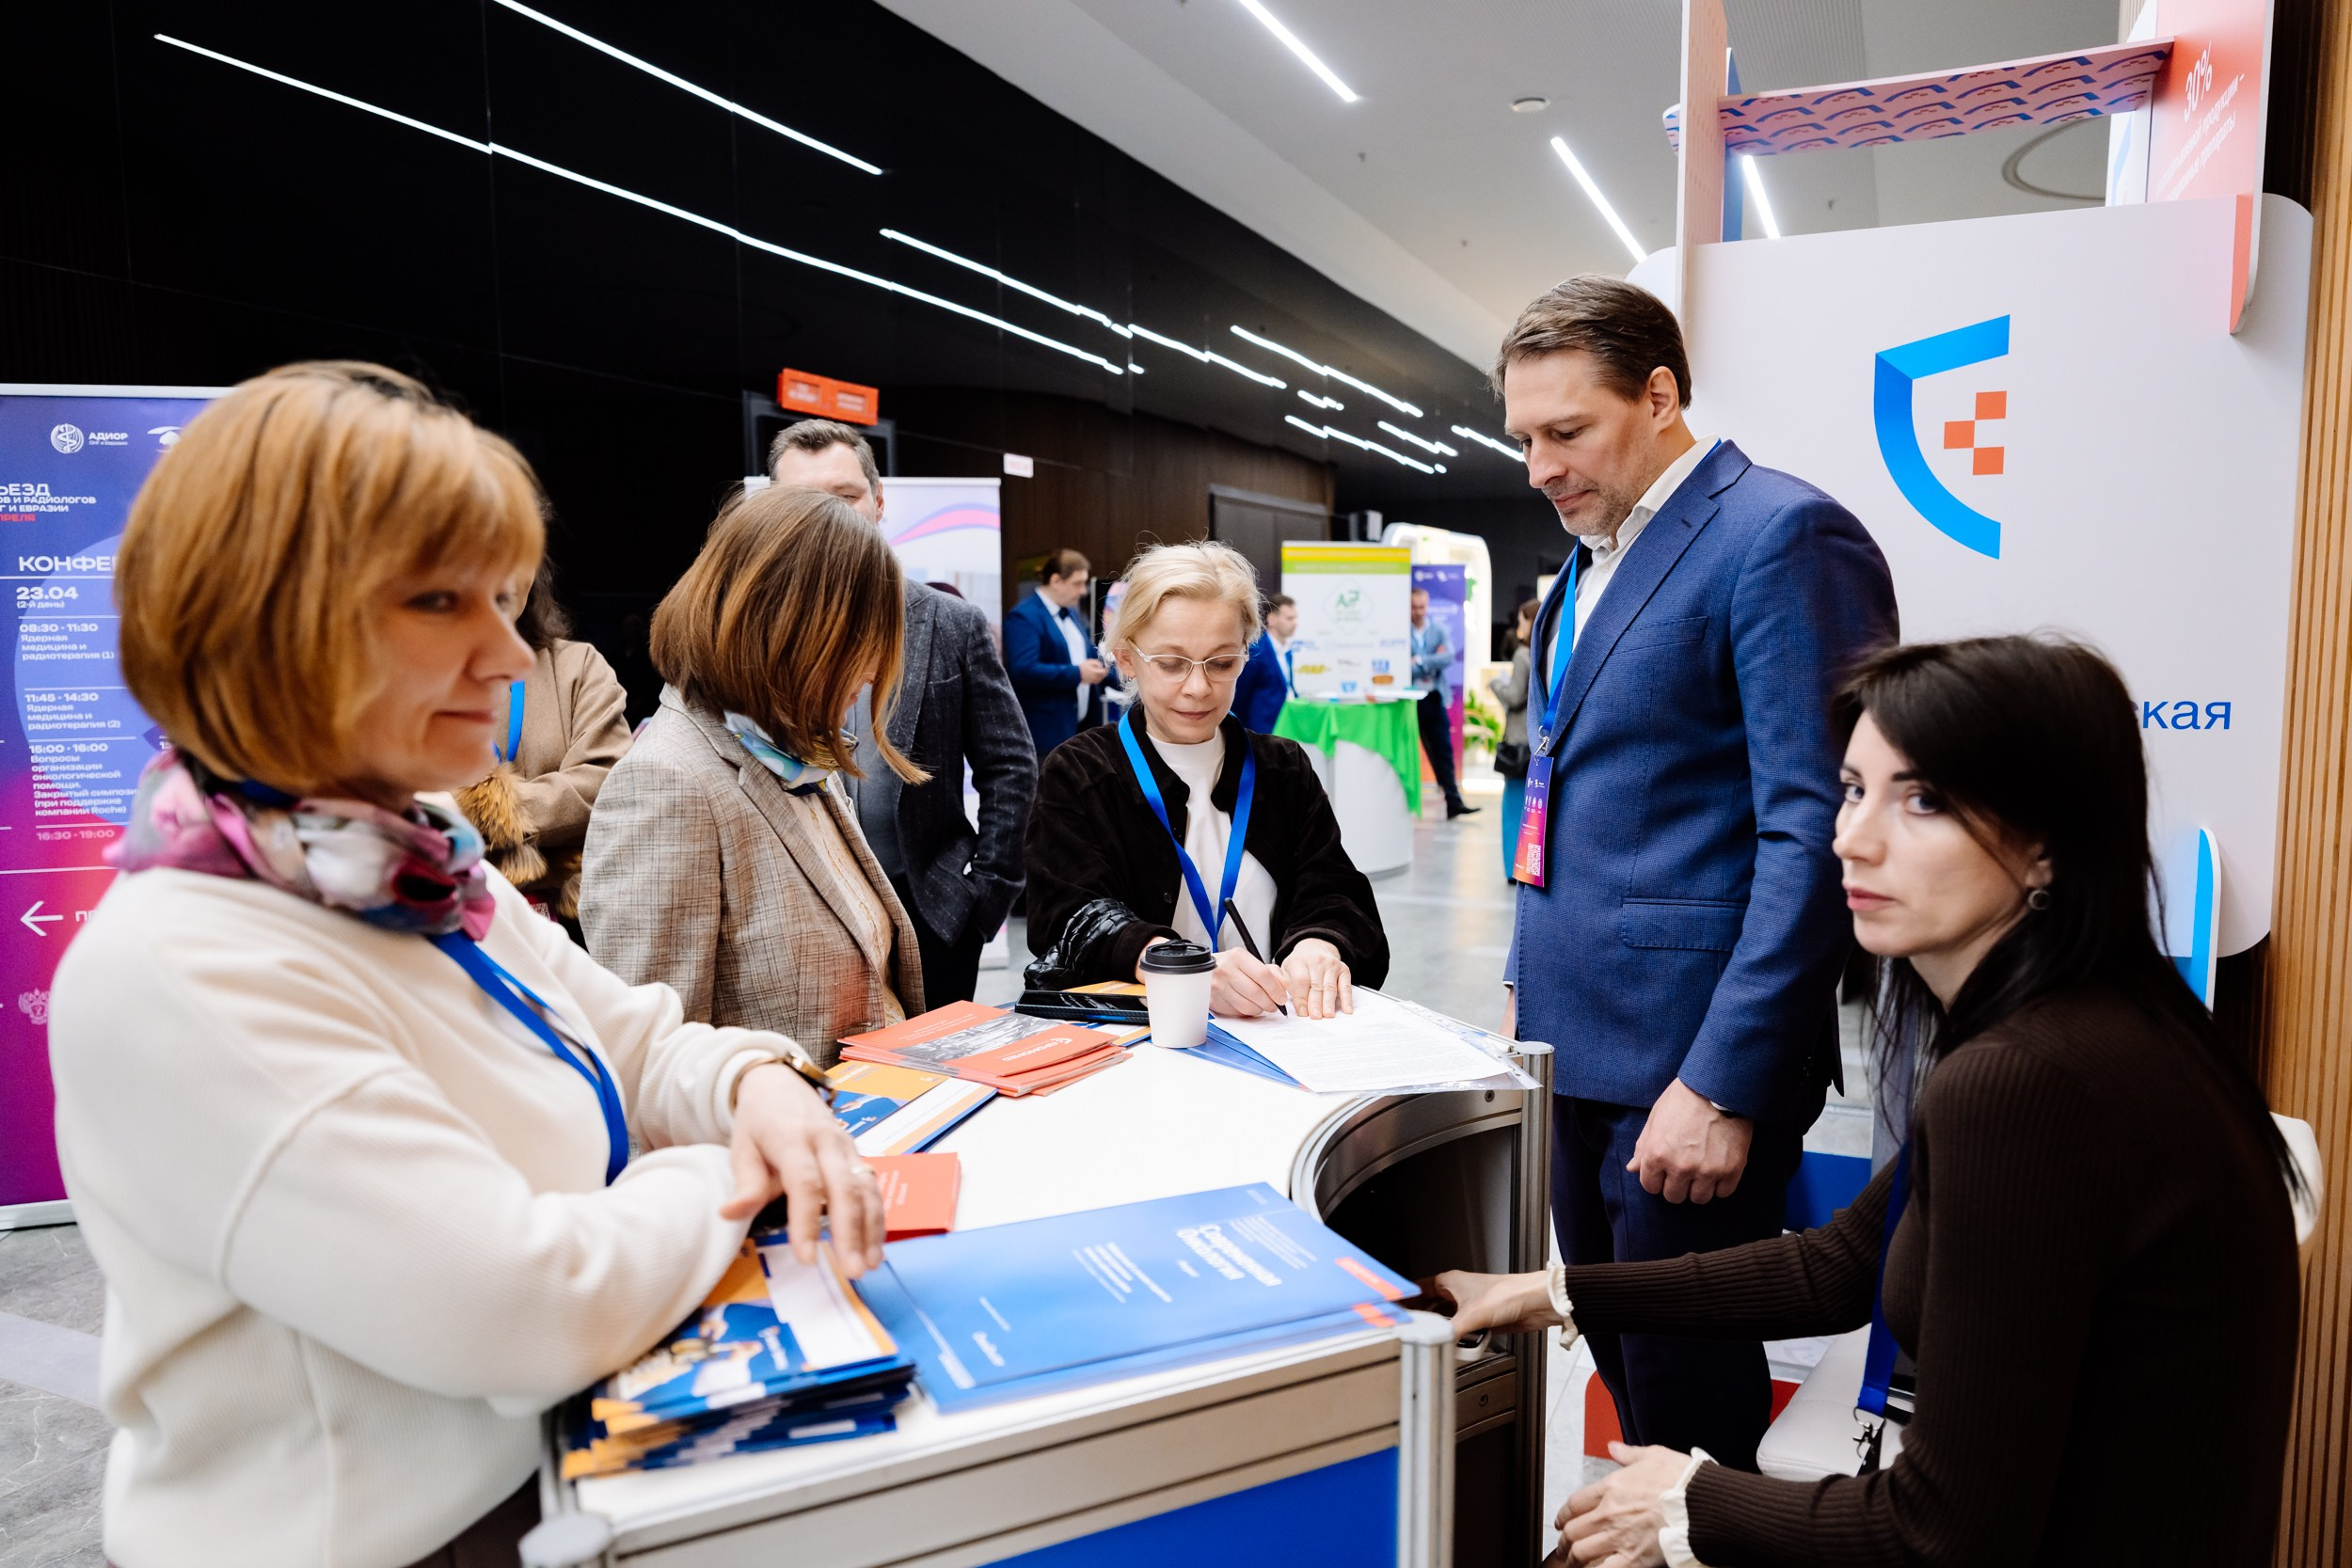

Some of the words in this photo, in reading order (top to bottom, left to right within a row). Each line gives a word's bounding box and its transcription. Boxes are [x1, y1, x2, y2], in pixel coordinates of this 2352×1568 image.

[2184, 40, 2212, 122] 30%
[88, 432, 128, 441] АДИОР
[24, 496, 97, 504] РАДИОЛОГОВ
[19, 556, 117, 572] КОНФЕ
[16, 586, 79, 600] 23.04
[19, 624, 58, 633] 08:30
[66, 623, 98, 632] 11:30
[21, 634, 68, 643] Ядерная
[22, 652, 100, 661] радиотерапия
[25, 694, 55, 702] 11:45
[64, 693, 98, 702] 14:30
[2130, 700, 2231, 730] кая
[28, 721, 106, 731] радиотерапия
[108, 720, 120, 729] (2)
[29, 745, 64, 754] 15:00
[72, 743, 108, 753] 16:00
[31, 755, 80, 763] Вопросы
[32, 764, 103, 772] организации
[32, 772, 121, 781] онкологической
[34, 790, 88, 799] Закрытый
[34, 800, 58, 808] (при
[60, 798, 122, 807] поддержке
[92, 806, 127, 815] Roche)
[80, 830, 114, 839] 19:00
